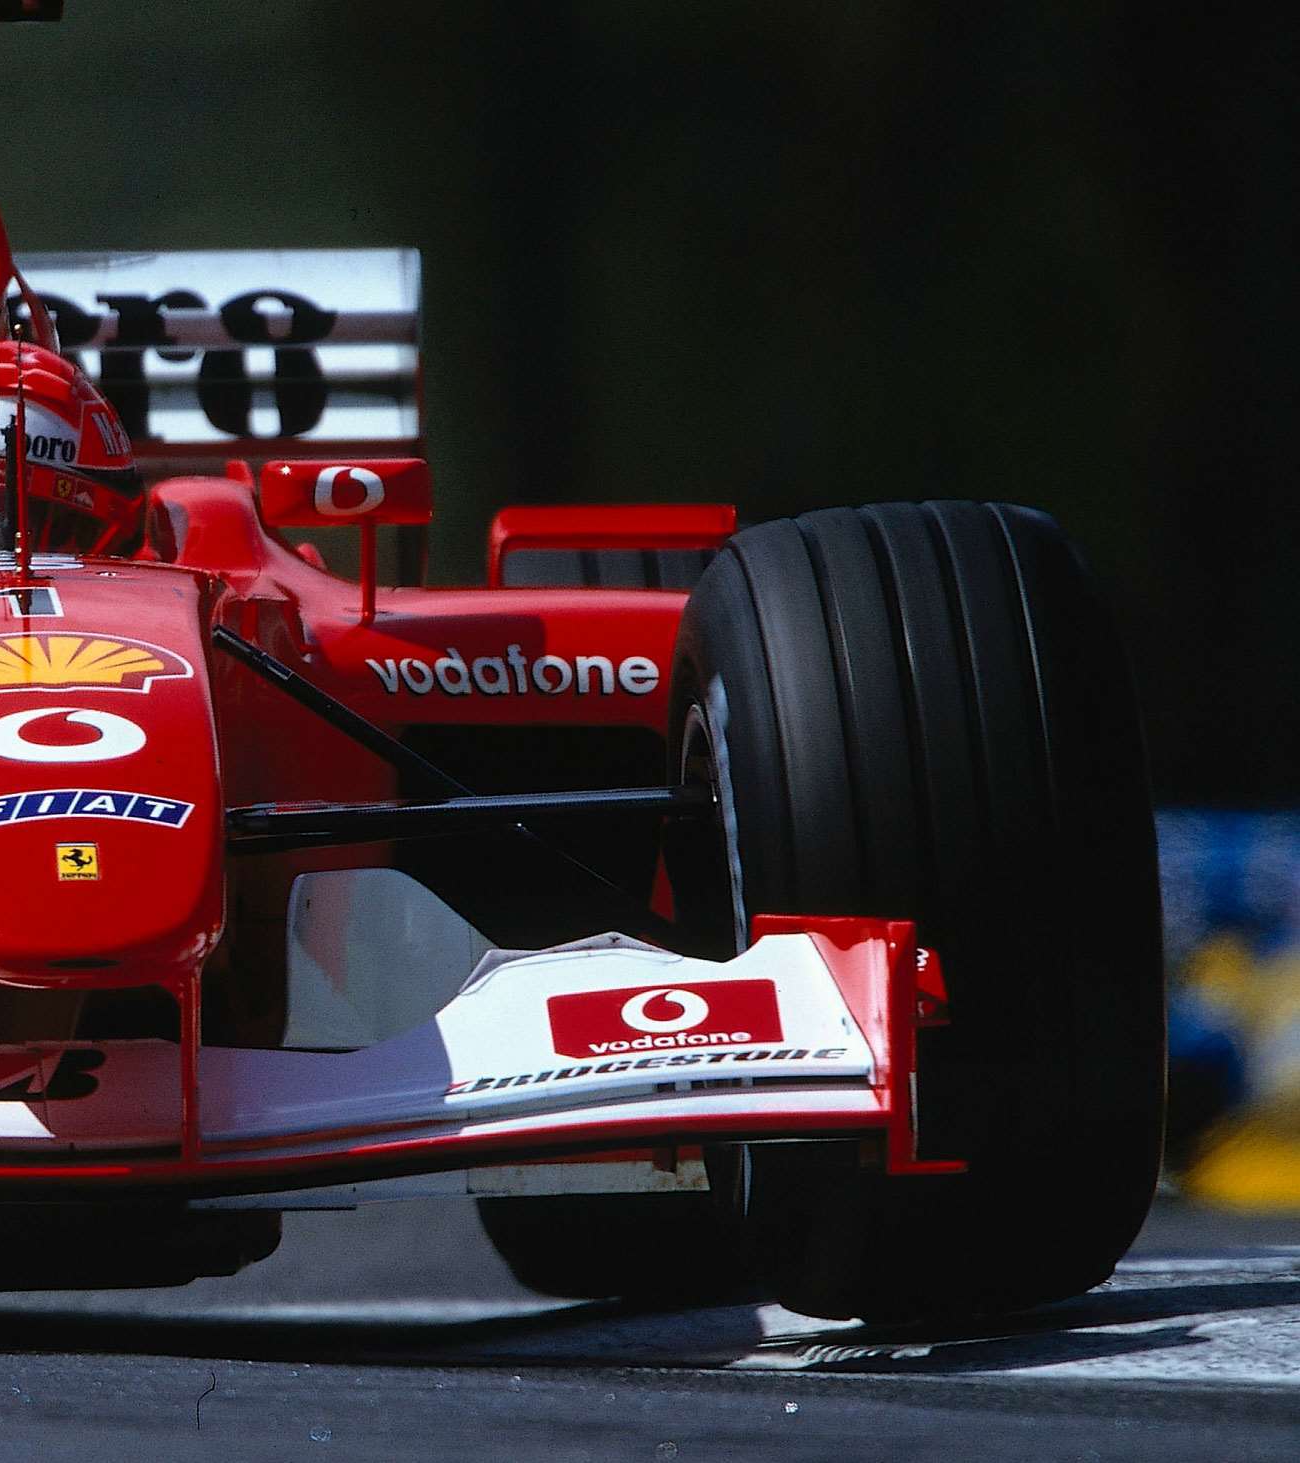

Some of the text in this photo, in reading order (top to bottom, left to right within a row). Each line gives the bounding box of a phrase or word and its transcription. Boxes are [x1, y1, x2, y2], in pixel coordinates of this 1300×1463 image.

[365, 643, 660, 696] vodafone
[588, 1031, 752, 1055] vodafone
[444, 1047, 849, 1096] BRIDGESTONE
